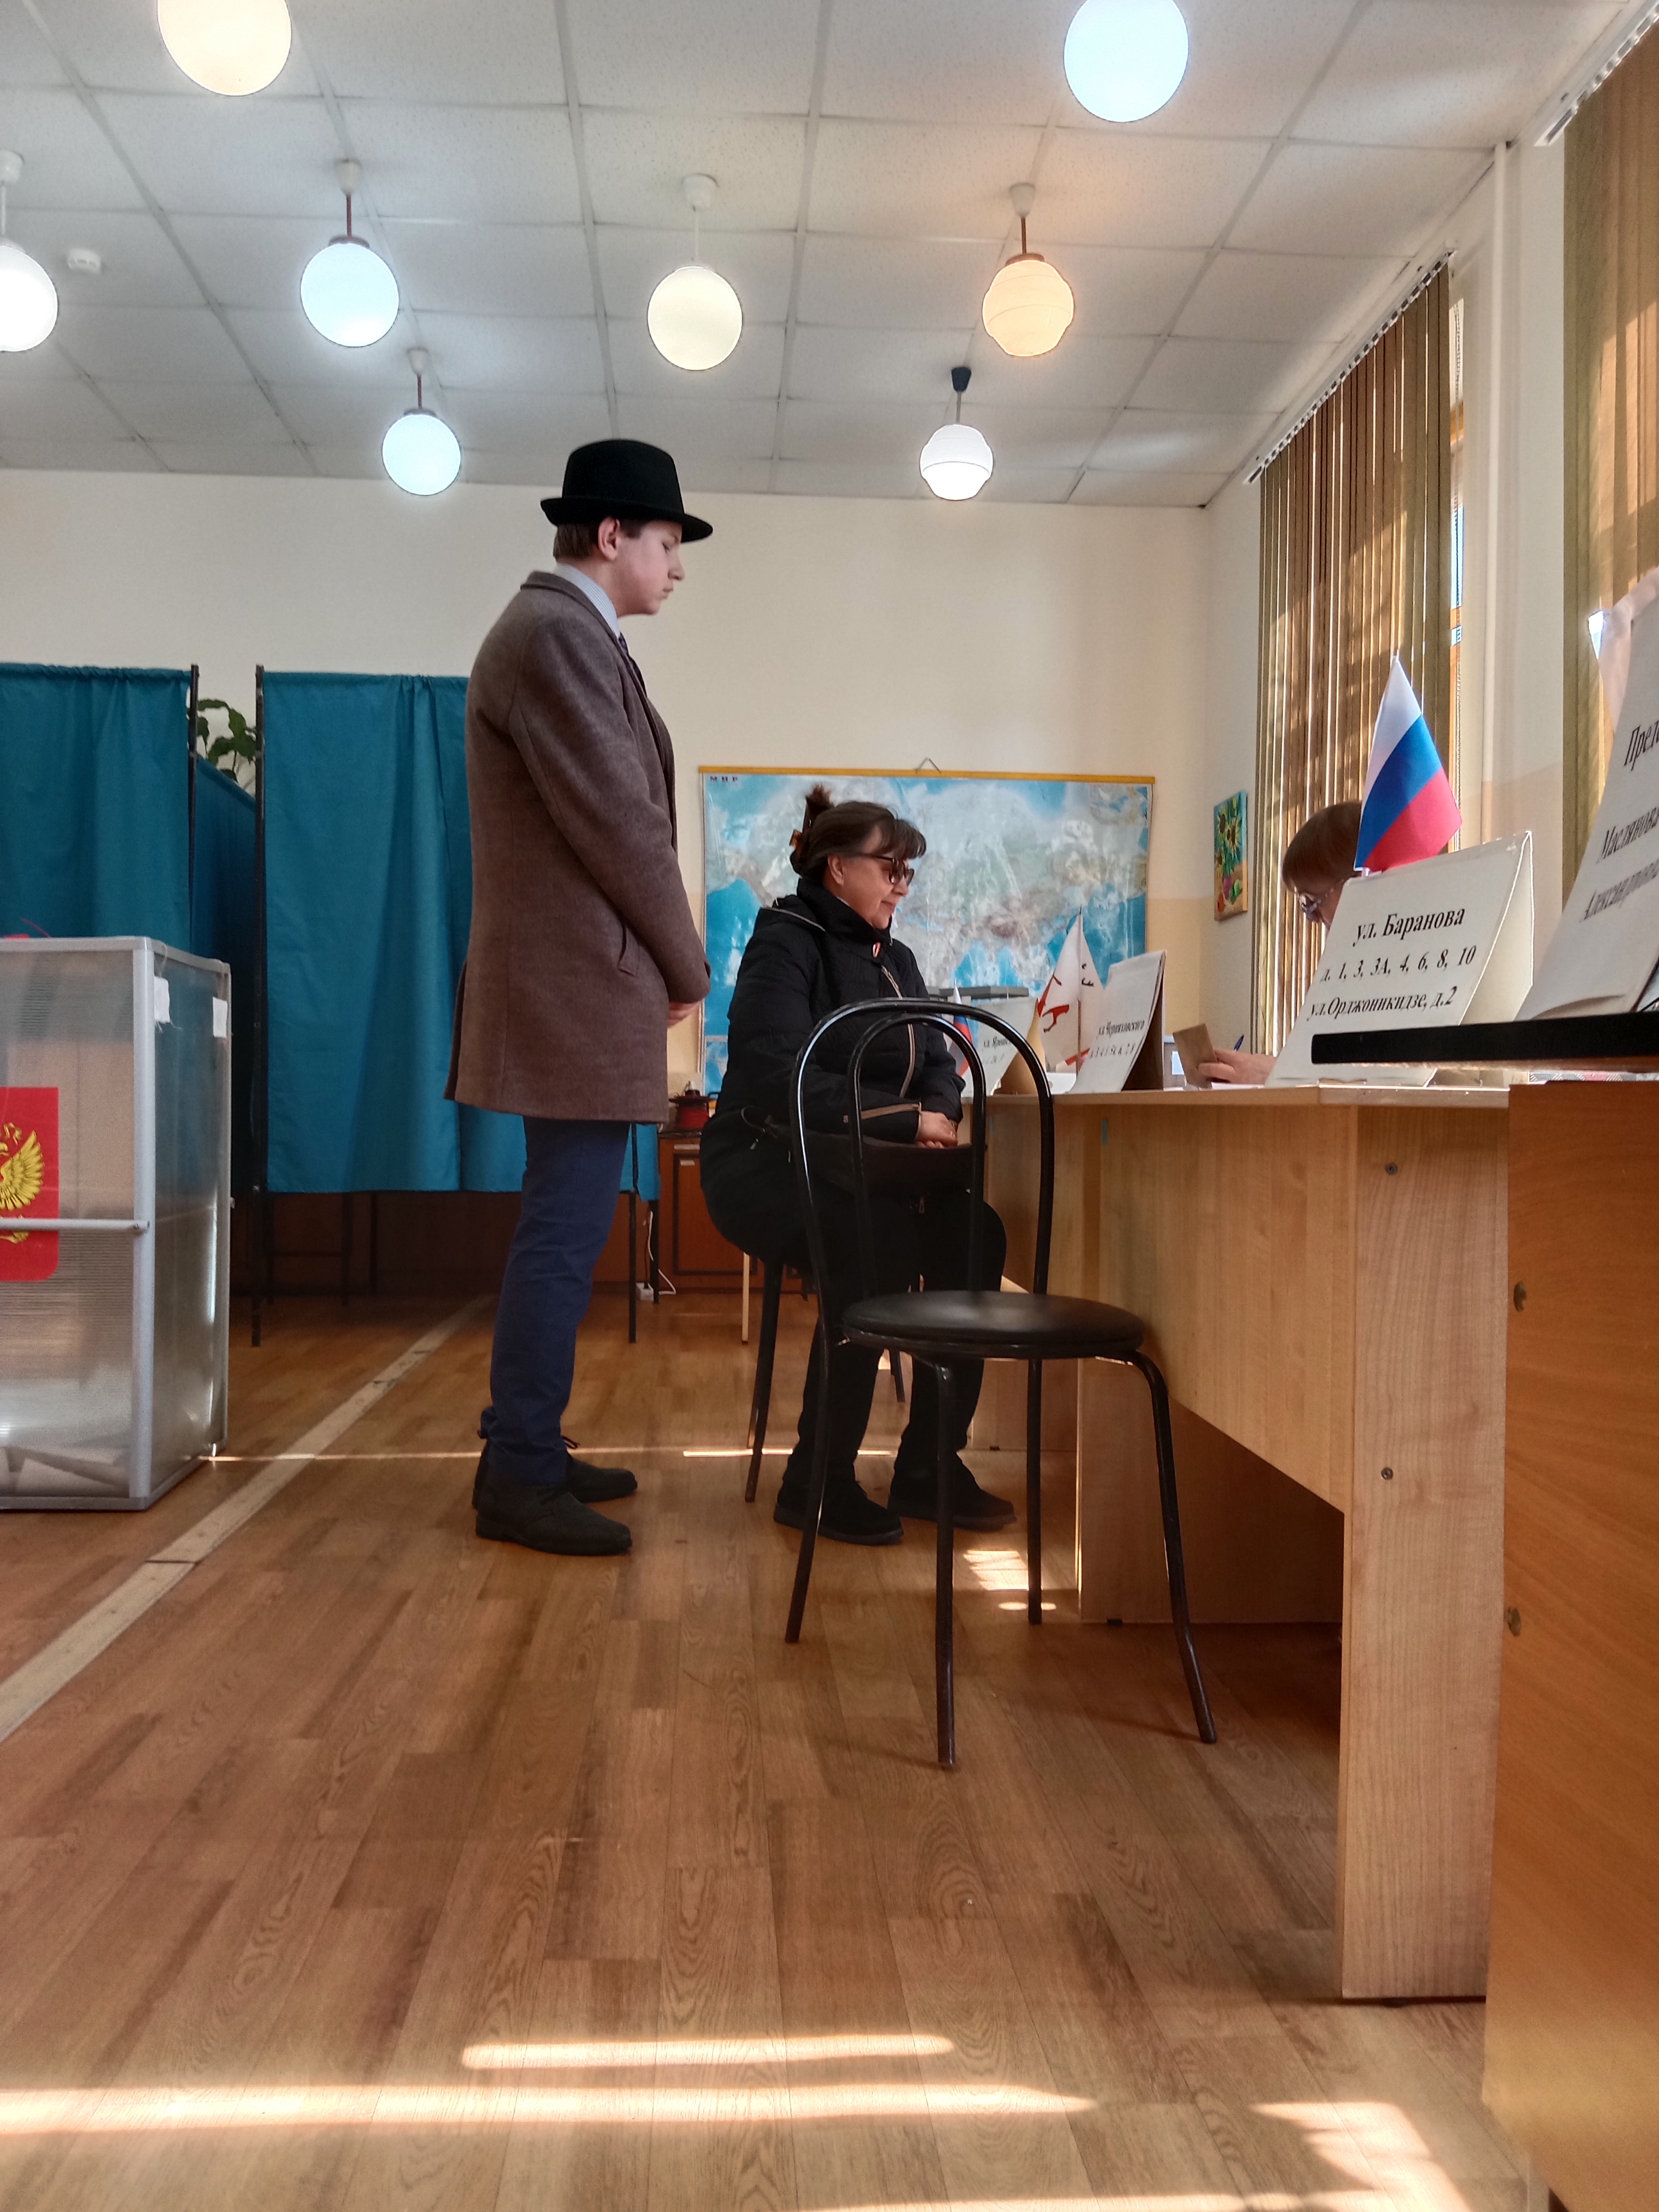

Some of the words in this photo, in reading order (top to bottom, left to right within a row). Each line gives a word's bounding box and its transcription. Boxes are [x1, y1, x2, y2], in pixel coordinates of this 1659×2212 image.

[1352, 923, 1376, 947] ул.
[1381, 908, 1465, 941] Баранова
[1353, 959, 1364, 979] 3,
[1370, 957, 1391, 978] 3А,
[1400, 954, 1410, 976] 4,
[1418, 951, 1430, 974] 6,
[1437, 949, 1448, 971] 8,
[1457, 945, 1477, 966] 10
